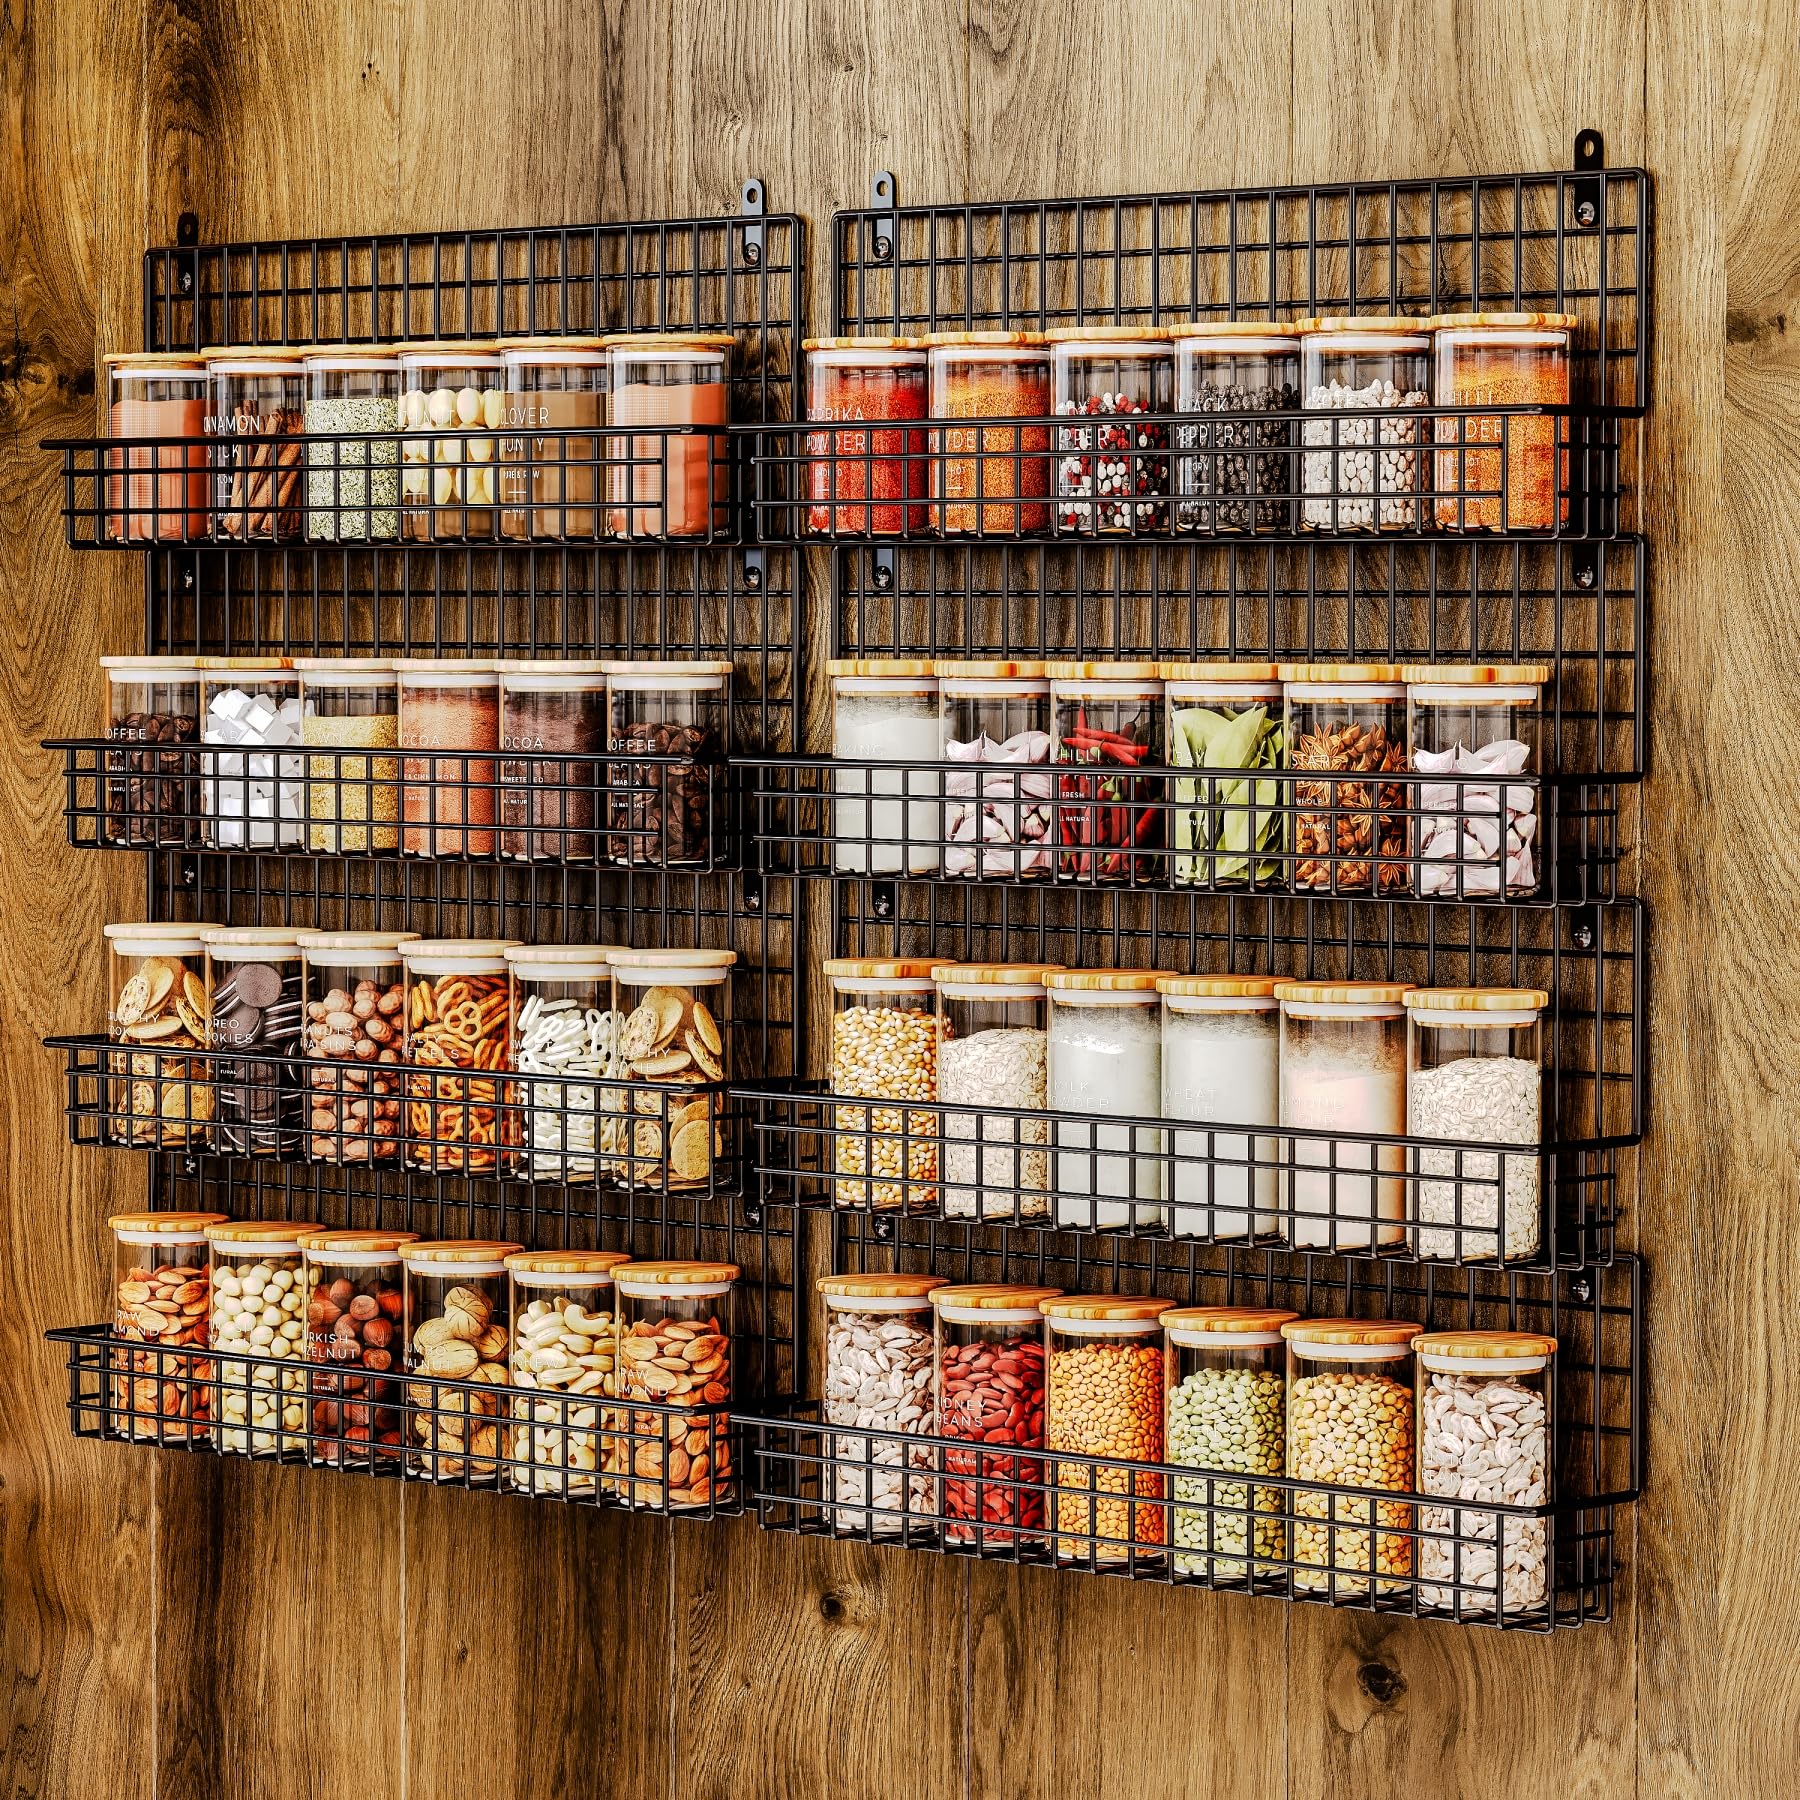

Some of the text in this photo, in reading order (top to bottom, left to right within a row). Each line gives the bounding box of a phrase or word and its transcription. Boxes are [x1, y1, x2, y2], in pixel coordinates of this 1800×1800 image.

[500, 407, 549, 425] CLOVER
[1176, 425, 1234, 443] PEPPR
[112, 1324, 160, 1337] LMOND
[302, 1344, 357, 1360] ZELNUT
[404, 1358, 453, 1372] ALNUT
[615, 1384, 669, 1398] LMOND
[935, 1411, 984, 1428] BEANS
